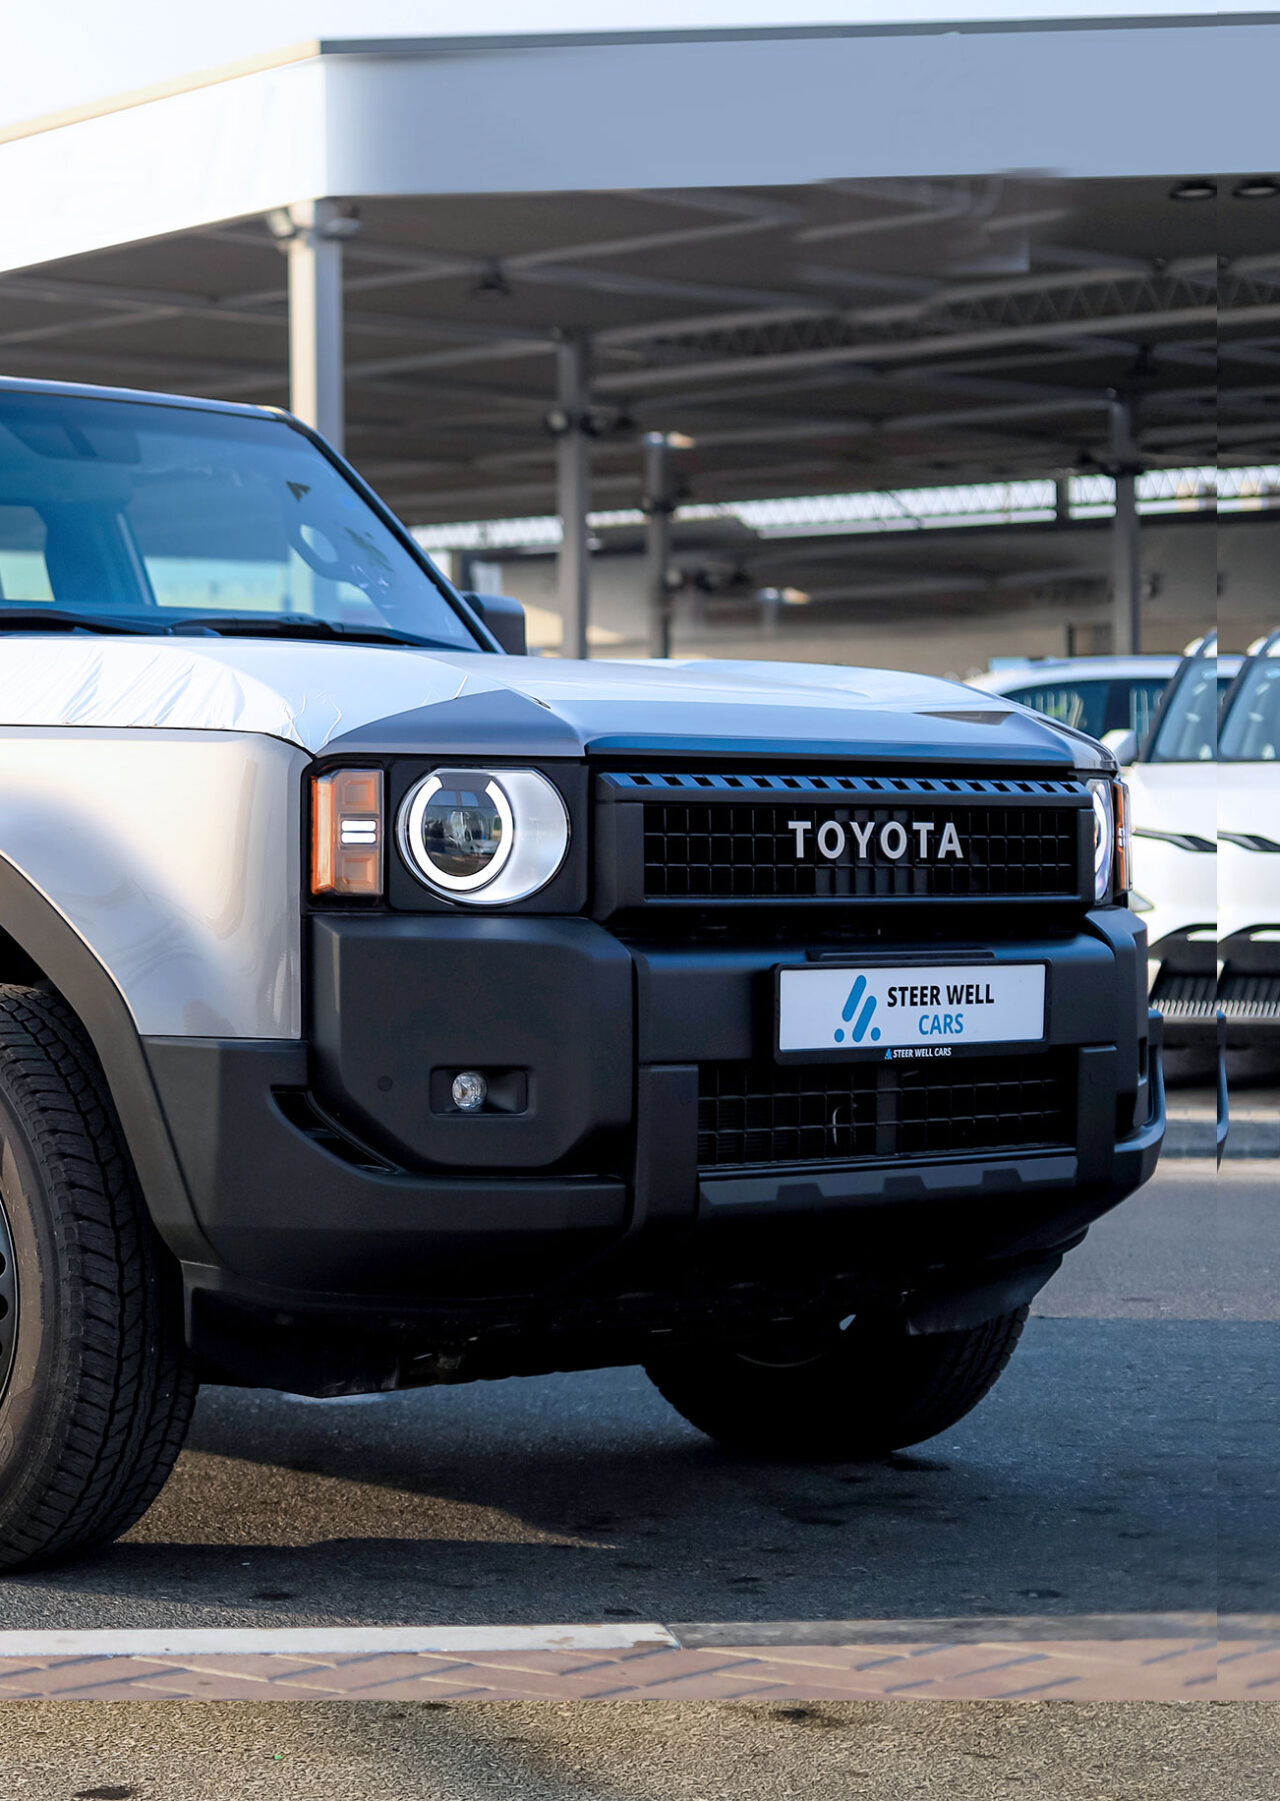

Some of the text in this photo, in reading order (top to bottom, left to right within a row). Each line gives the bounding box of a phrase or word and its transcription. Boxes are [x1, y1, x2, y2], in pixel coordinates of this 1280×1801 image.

[788, 821, 964, 859] TOYOTA
[887, 984, 995, 1007] STEER WELL
[919, 1013, 964, 1035] CARS
[893, 1048, 952, 1058] STEER WELL CARS
